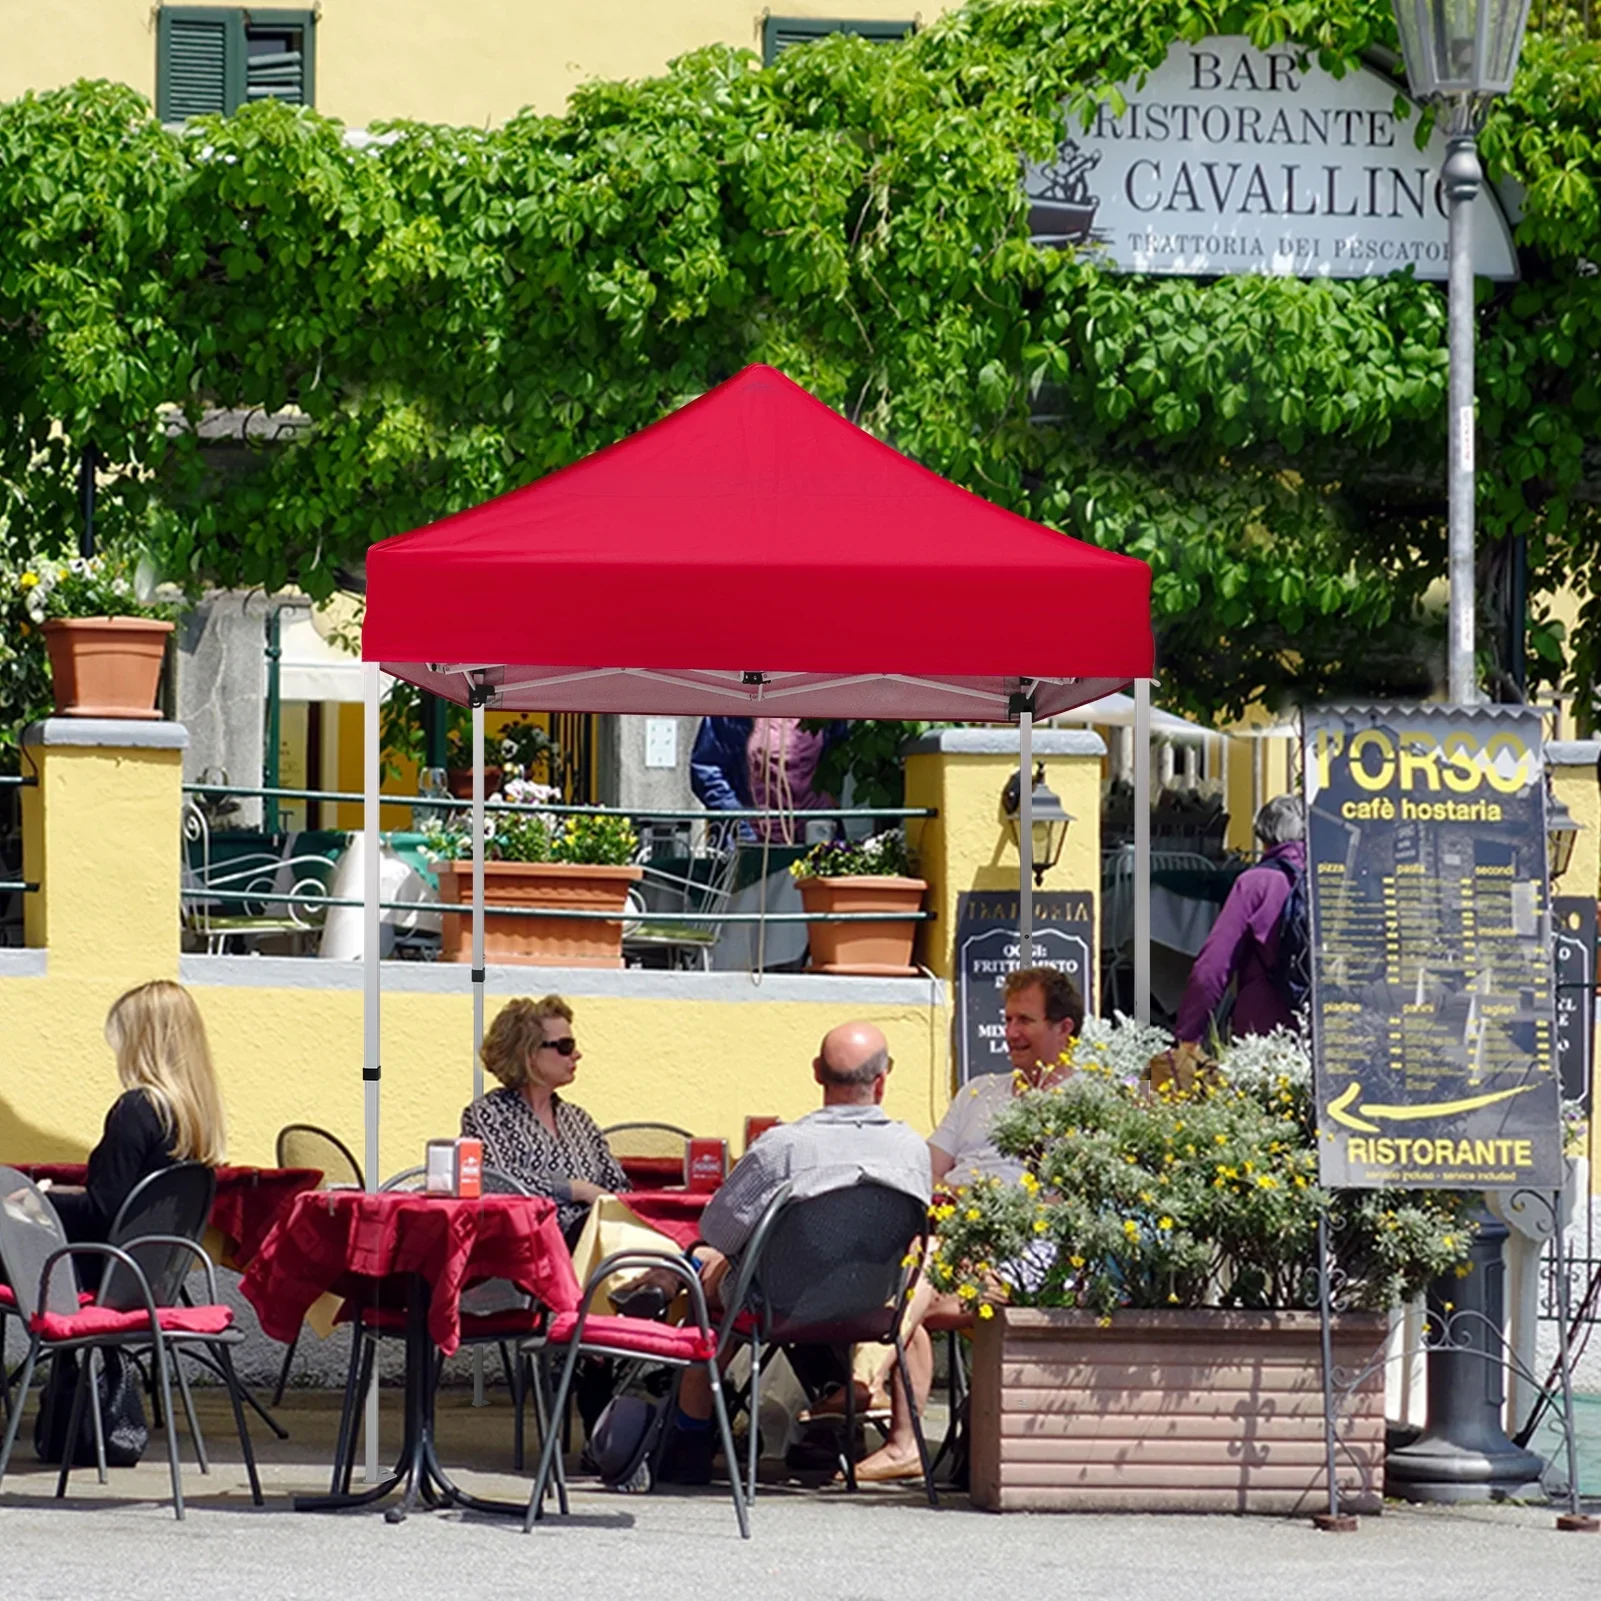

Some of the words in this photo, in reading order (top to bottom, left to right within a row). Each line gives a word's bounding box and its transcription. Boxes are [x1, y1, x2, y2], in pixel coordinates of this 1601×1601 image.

[1188, 51, 1300, 92] BAR
[1092, 101, 1395, 148] RISTORANTE
[1127, 232, 1265, 257] TRATTORIA
[1278, 236, 1321, 260] DEI
[1341, 797, 1396, 820] cafè
[1401, 798, 1503, 822] hostaria
[1347, 1137, 1533, 1166] RISTORANTE
